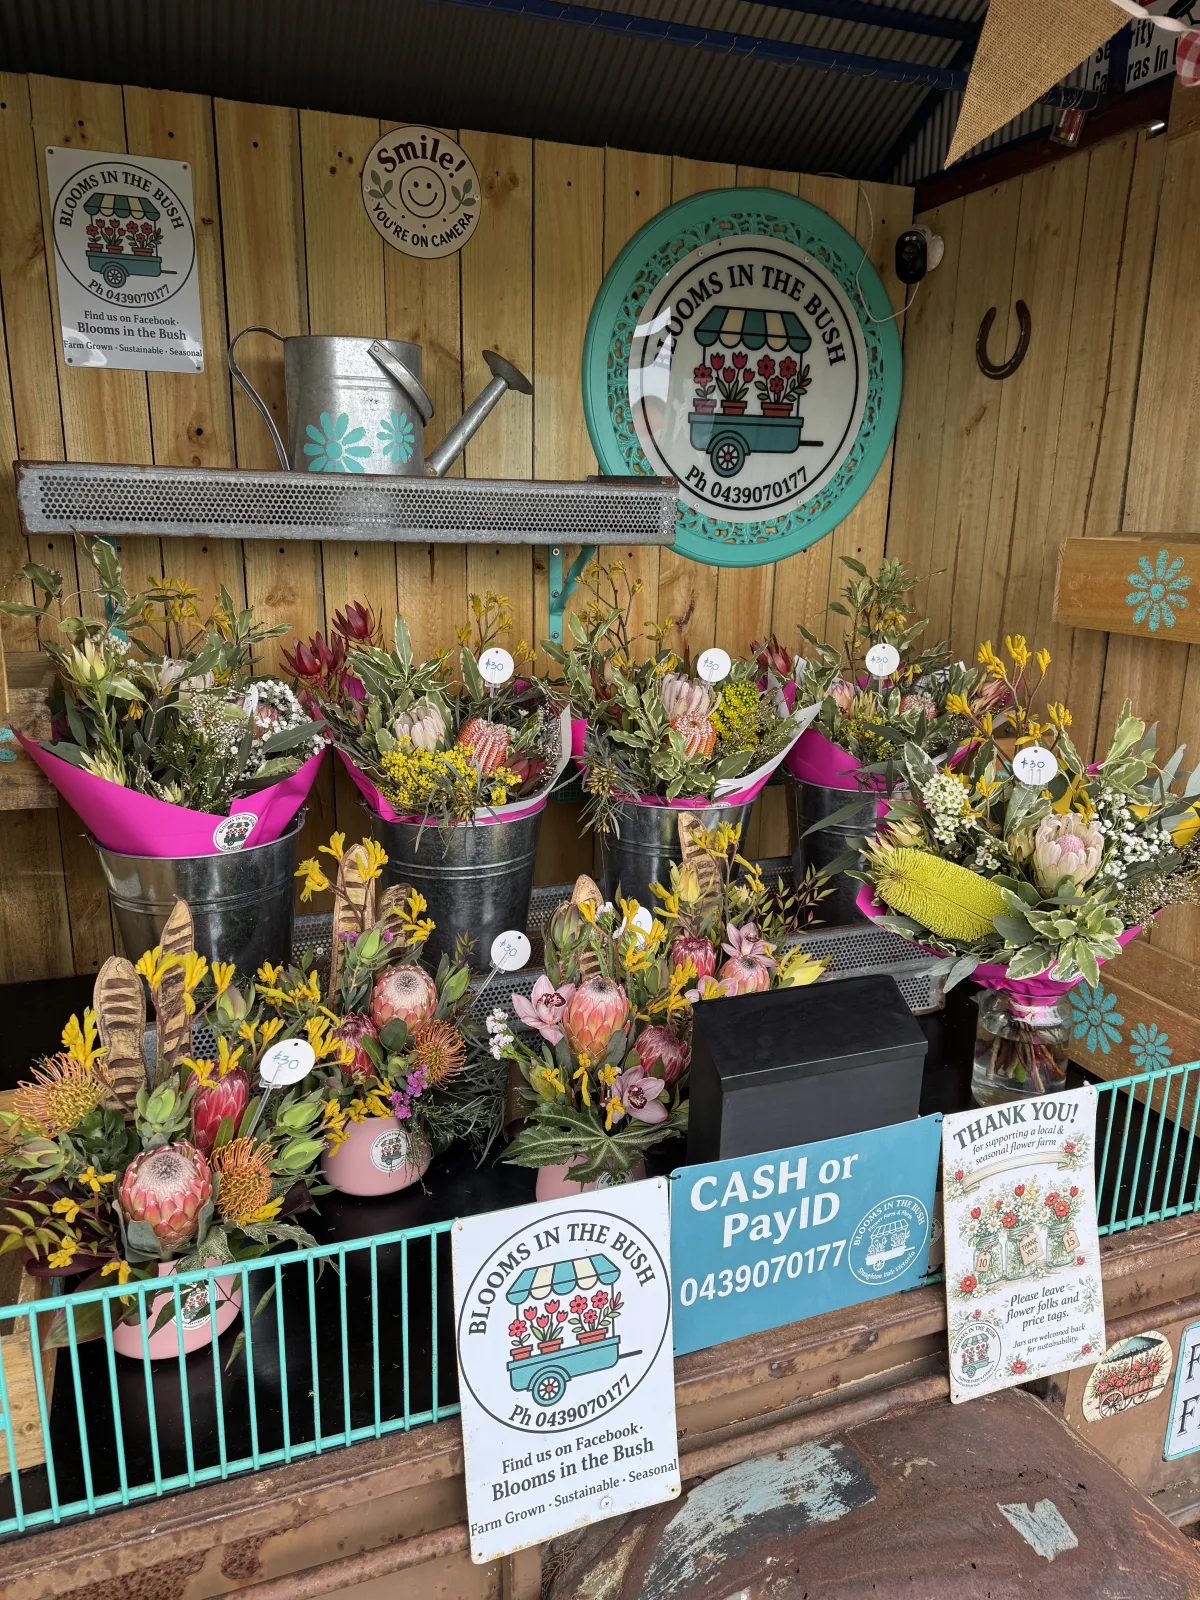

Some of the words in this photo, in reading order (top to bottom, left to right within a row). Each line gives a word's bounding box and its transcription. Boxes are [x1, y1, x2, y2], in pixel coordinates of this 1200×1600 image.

[1095, 19, 1155, 64] Serity
[1093, 57, 1150, 94] Caras
[1154, 45, 1168, 73] In
[377, 135, 466, 178] Smile!
[60, 175, 99, 228] BLOOMS
[102, 170, 119, 185] IN
[122, 171, 152, 193] THE
[152, 188, 185, 230] BUSH
[372, 202, 410, 242] YOU'RE
[411, 233, 429, 247] ON
[431, 212, 474, 247] CAMERA
[88, 279, 104, 295] Ph
[106, 284, 171, 304] 0439070177
[77, 322, 120, 336] Blooms
[123, 326, 135, 337] in
[137, 327, 156, 338] the
[159, 329, 187, 340] Bush
[84, 310, 105, 320] Find
[107, 313, 118, 321] us
[120, 315, 131, 323] on
[653, 271, 724, 370] BLOOMS
[727, 264, 755, 288] IN
[761, 265, 805, 302] THE
[803, 292, 847, 367] BUSH
[63, 341, 84, 349] Farm
[86, 342, 113, 351] Grown
[119, 344, 164, 355] Sustainable
[169, 348, 203, 357] Seasonal
[684, 465, 707, 493] Ph
[710, 465, 808, 503] 0439070177
[485, 658, 504, 671] $30
[1021, 757, 1045, 768] $30
[500, 939, 517, 956] $30
[272, 1051, 299, 1069] $30
[953, 1104, 1027, 1150] THANK
[1031, 1101, 1079, 1124] YOU!
[973, 1144, 984, 1155] for
[985, 1129, 1029, 1148] supporting
[1037, 1124, 1057, 1135] local
[1057, 1125, 1065, 1135] &
[976, 1144, 1009, 1164] seasonal
[1009, 1139, 1035, 1154] flower
[1035, 1137, 1057, 1149] farm
[690, 1156, 808, 1212] CASH
[818, 1154, 859, 1185] or
[723, 1192, 841, 1248] PayID
[854, 1208, 882, 1246] BLOOMS
[883, 1201, 894, 1211] IN
[896, 1199, 912, 1208] THE
[911, 1203, 926, 1226] BUSH
[1021, 1238, 1039, 1251] THANK
[1066, 1237, 1075, 1247] 15
[469, 1242, 531, 1335] BLOOMS
[534, 1227, 560, 1252] IN
[567, 1223, 610, 1244] THE
[610, 1232, 655, 1287] BUSH
[680, 1239, 847, 1307] 0439070177
[979, 1259, 988, 1268] 10
[1005, 1306, 1035, 1324] flower
[1036, 1298, 1059, 1315] folks
[1061, 1292, 1079, 1306] and
[1011, 1292, 1039, 1307] Please
[1042, 1285, 1065, 1297] leave
[1013, 1340, 1026, 1349] Jars
[1039, 1327, 1069, 1341] welcomed
[1070, 1323, 1086, 1333] back
[1022, 1315, 1045, 1332] price
[1047, 1310, 1069, 1322] tags.
[1026, 1346, 1035, 1356] for
[509, 1404, 531, 1427] Ph
[535, 1374, 631, 1427] 0439070177
[491, 1468, 556, 1502] Blooms
[560, 1461, 577, 1478] in
[581, 1452, 609, 1471] the
[613, 1437, 655, 1463] Bush
[502, 1452, 533, 1474] Find
[536, 1450, 552, 1464] us
[555, 1443, 573, 1458] on
[470, 1518, 502, 1537] Farm
[505, 1504, 546, 1525] Grown
[554, 1477, 620, 1508] Sustainable
[628, 1458, 678, 1483] Seasonal
